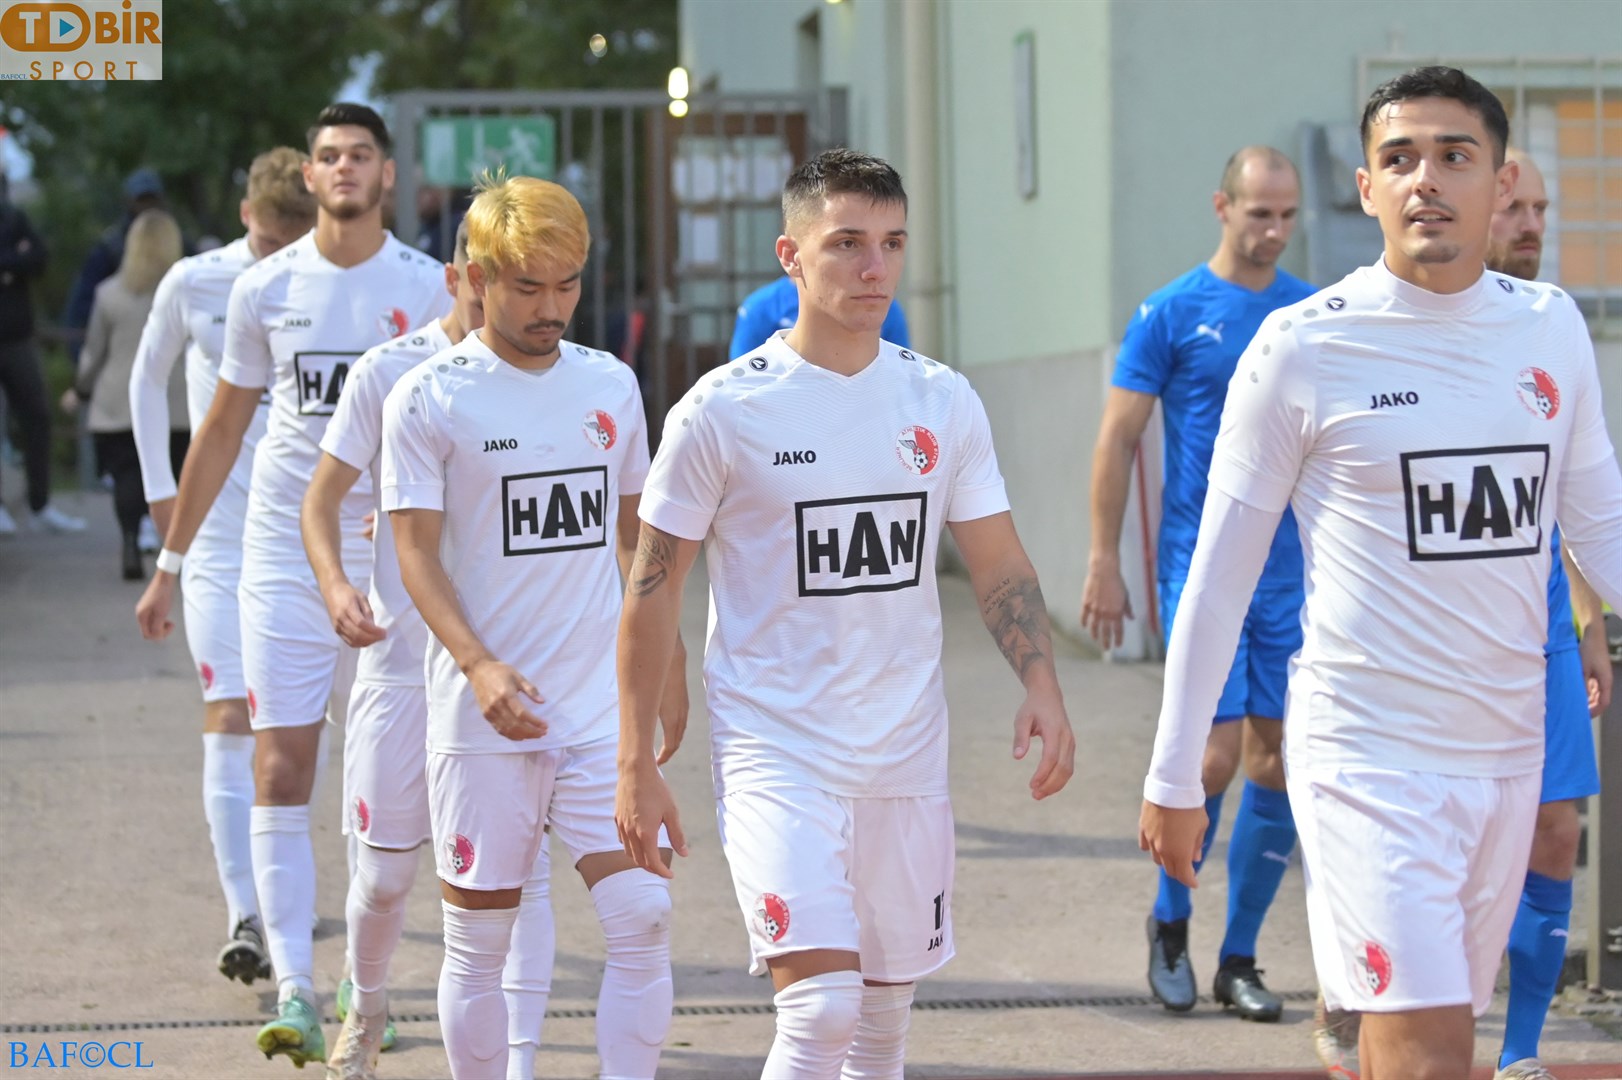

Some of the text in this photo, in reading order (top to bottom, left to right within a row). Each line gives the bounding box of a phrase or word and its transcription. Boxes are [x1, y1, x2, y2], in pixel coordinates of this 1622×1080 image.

[285, 318, 311, 328] JAKO
[303, 362, 350, 404] HA
[1370, 391, 1419, 410] JAKO
[483, 438, 518, 452] JAKO
[773, 450, 817, 465] JAKO
[512, 483, 602, 539] HAN
[1417, 465, 1540, 540] HAN
[808, 511, 917, 578] HAN
[927, 932, 943, 951] JAK
